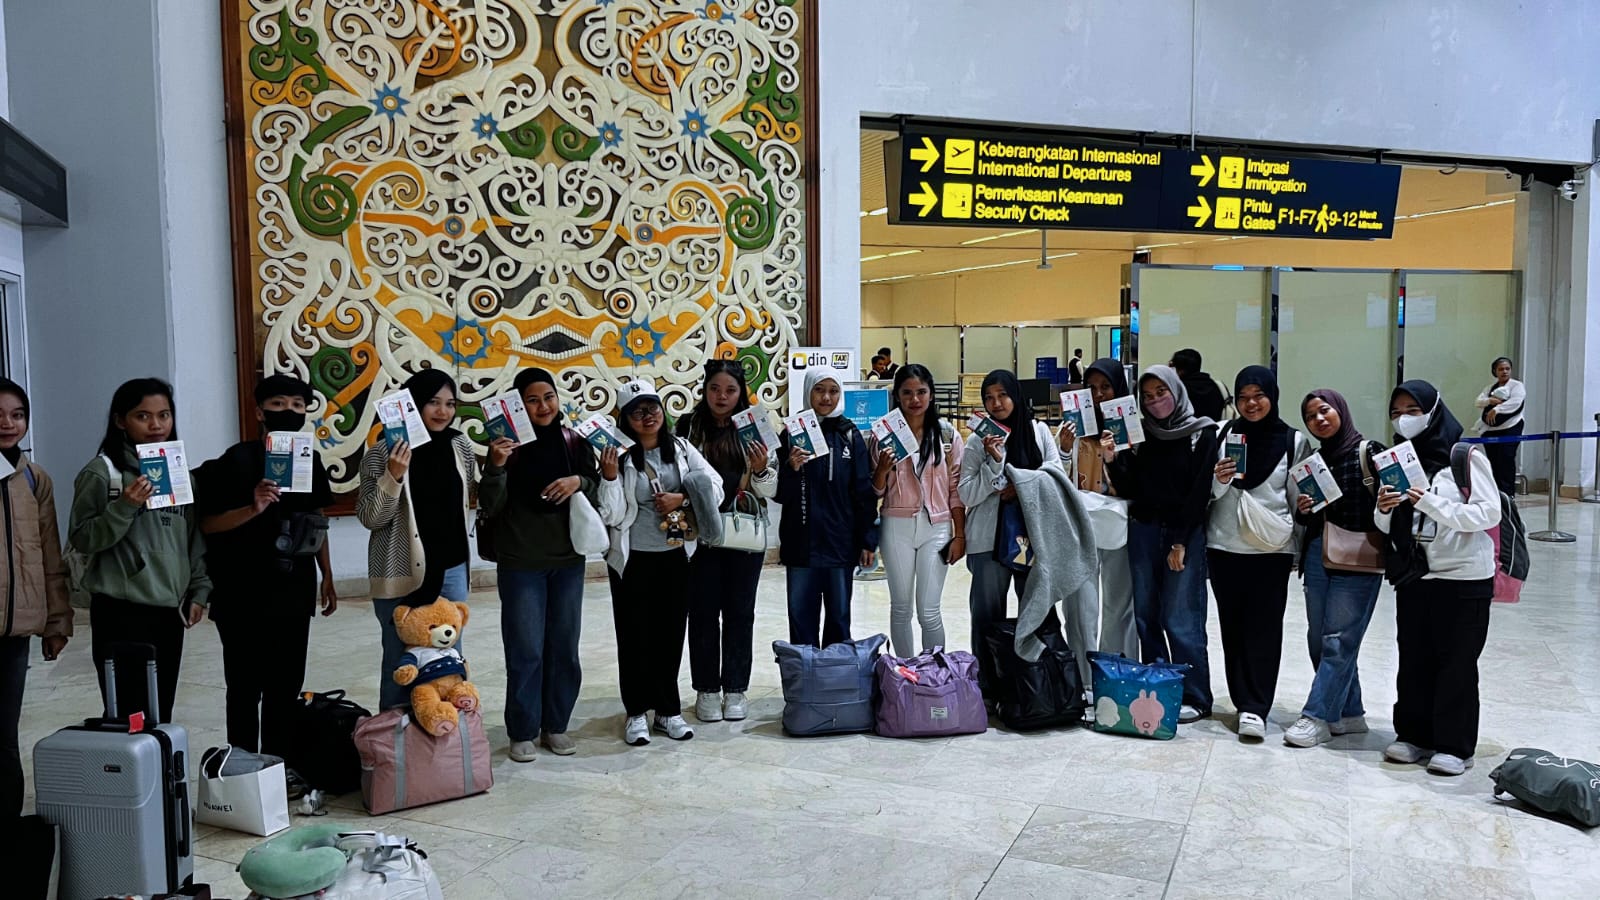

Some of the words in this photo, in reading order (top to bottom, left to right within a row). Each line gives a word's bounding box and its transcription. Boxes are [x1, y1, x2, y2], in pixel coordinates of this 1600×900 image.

[978, 140, 1079, 164] Keberangkatan
[1081, 146, 1161, 166] Internasional
[977, 159, 1060, 179] International
[1062, 164, 1132, 183] Departures
[1247, 159, 1290, 177] Imigrasi
[975, 183, 1057, 203] Pemeriksaan
[1058, 188, 1124, 206] Keamanan
[1245, 175, 1307, 195] Immigration
[975, 202, 1027, 223] Security
[1029, 204, 1070, 222] Check
[1243, 197, 1273, 214] Pintu
[1242, 214, 1276, 231] Gates
[1277, 207, 1318, 226] F1-F7
[1328, 210, 1358, 227] 9-12
